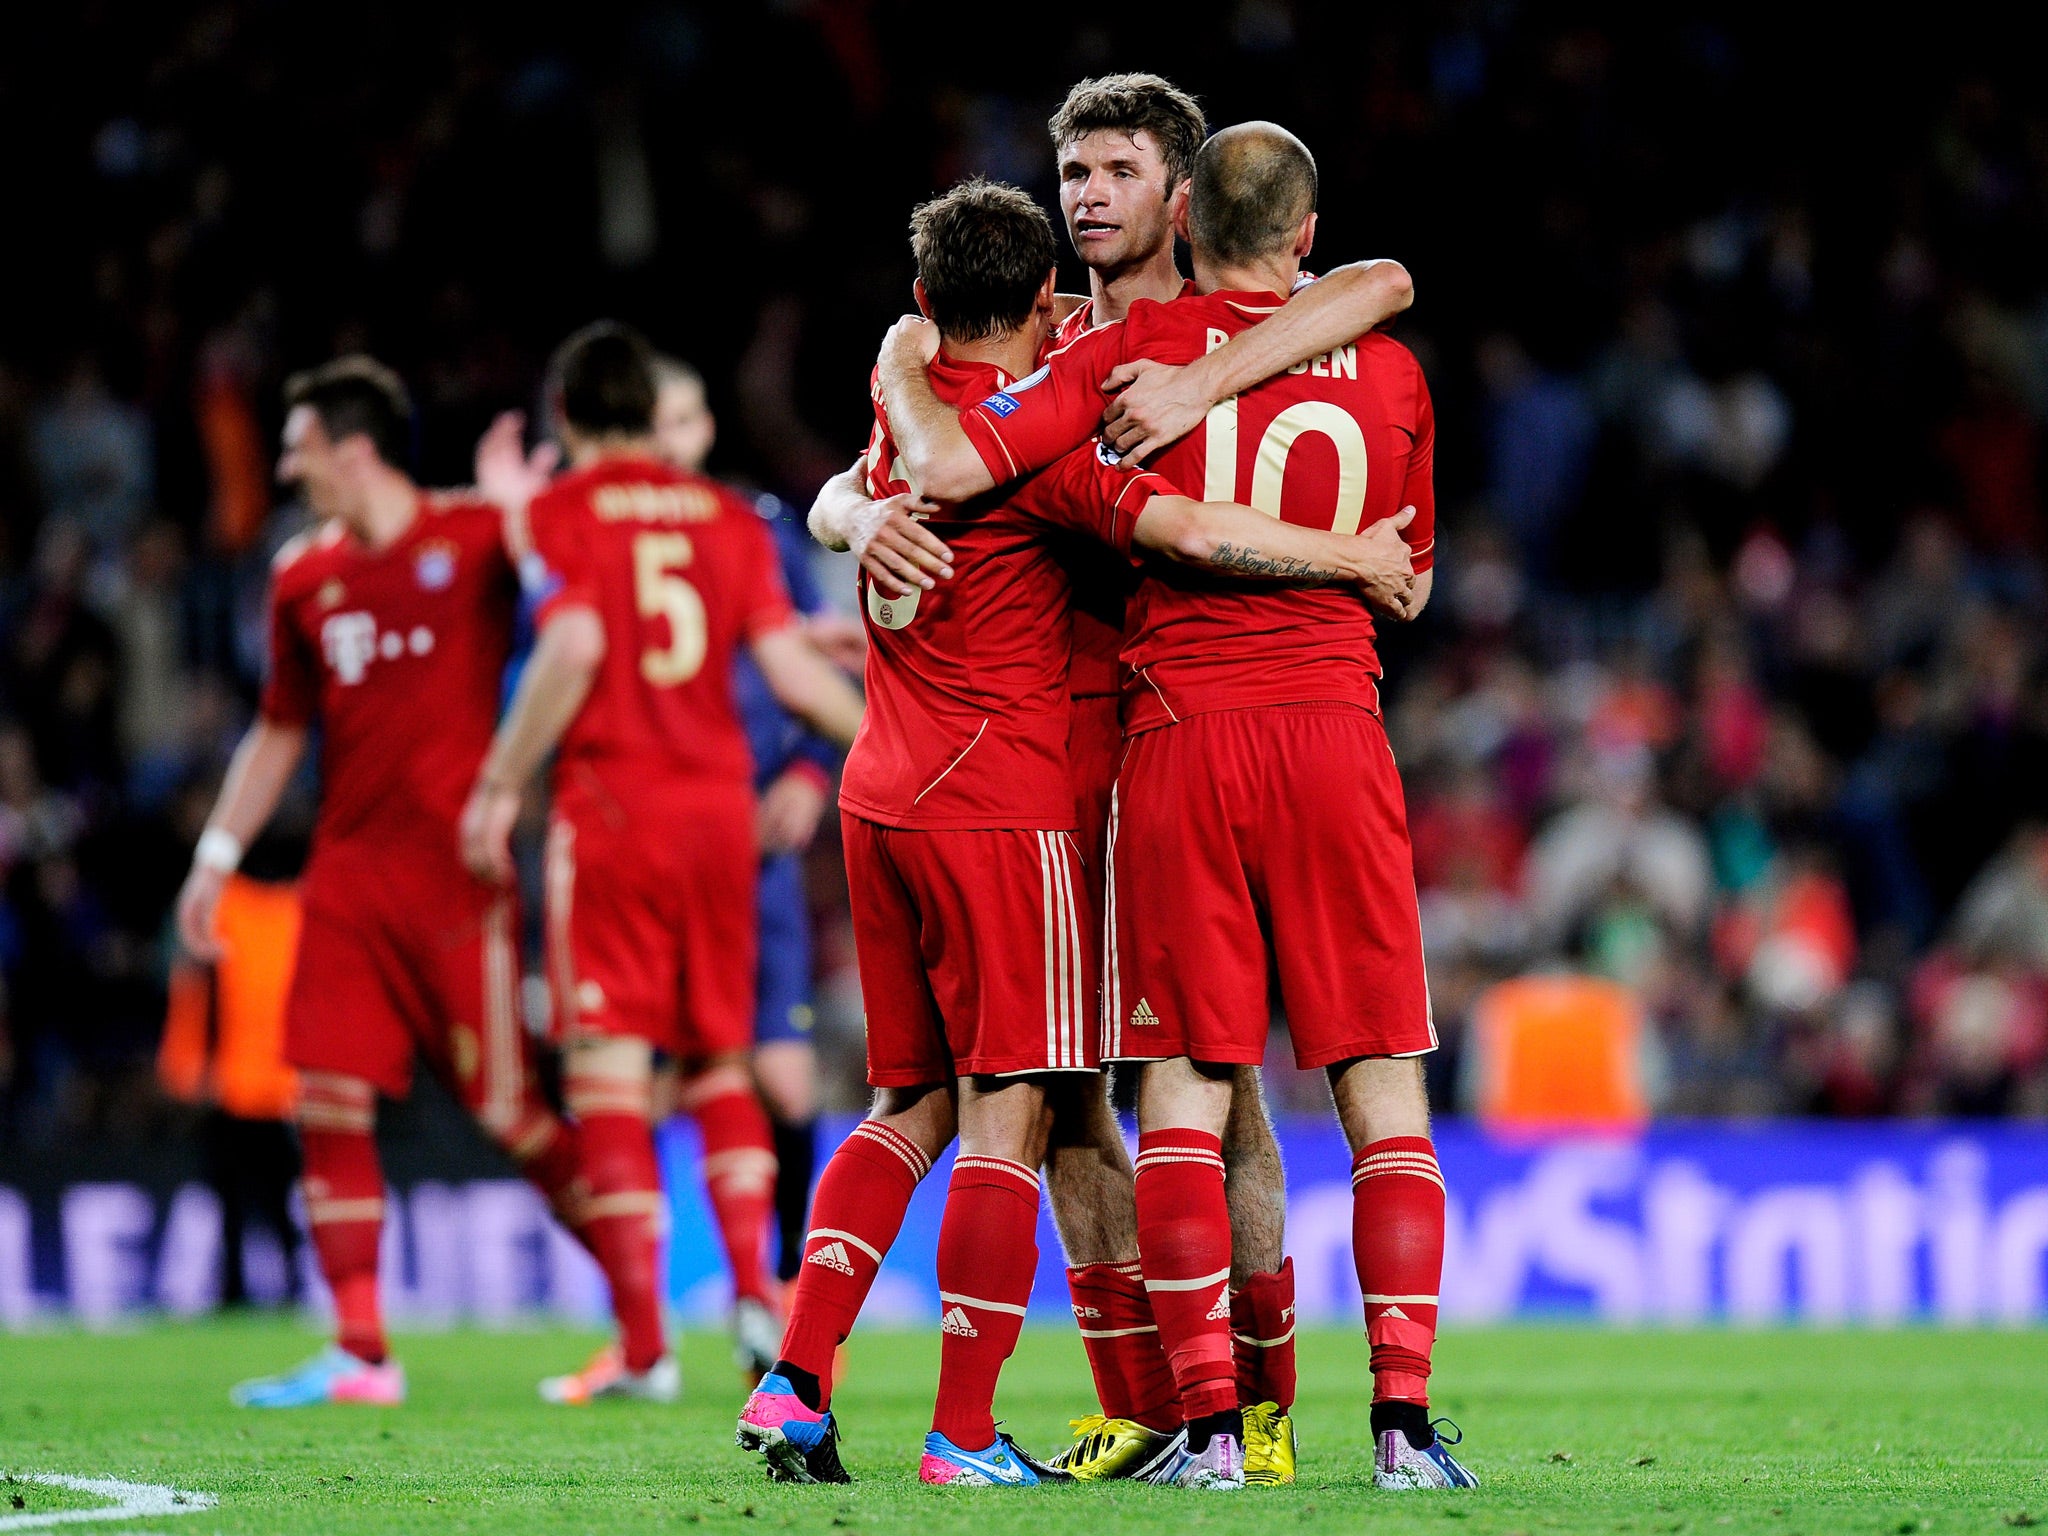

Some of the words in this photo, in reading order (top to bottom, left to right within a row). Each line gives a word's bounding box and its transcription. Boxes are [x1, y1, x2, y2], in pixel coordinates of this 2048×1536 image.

[988, 396, 1015, 413] SPECT
[1203, 394, 1368, 535] 10
[633, 532, 707, 688] 5
[1130, 1014, 1160, 1025] adidas
[807, 1253, 855, 1276] adidas
